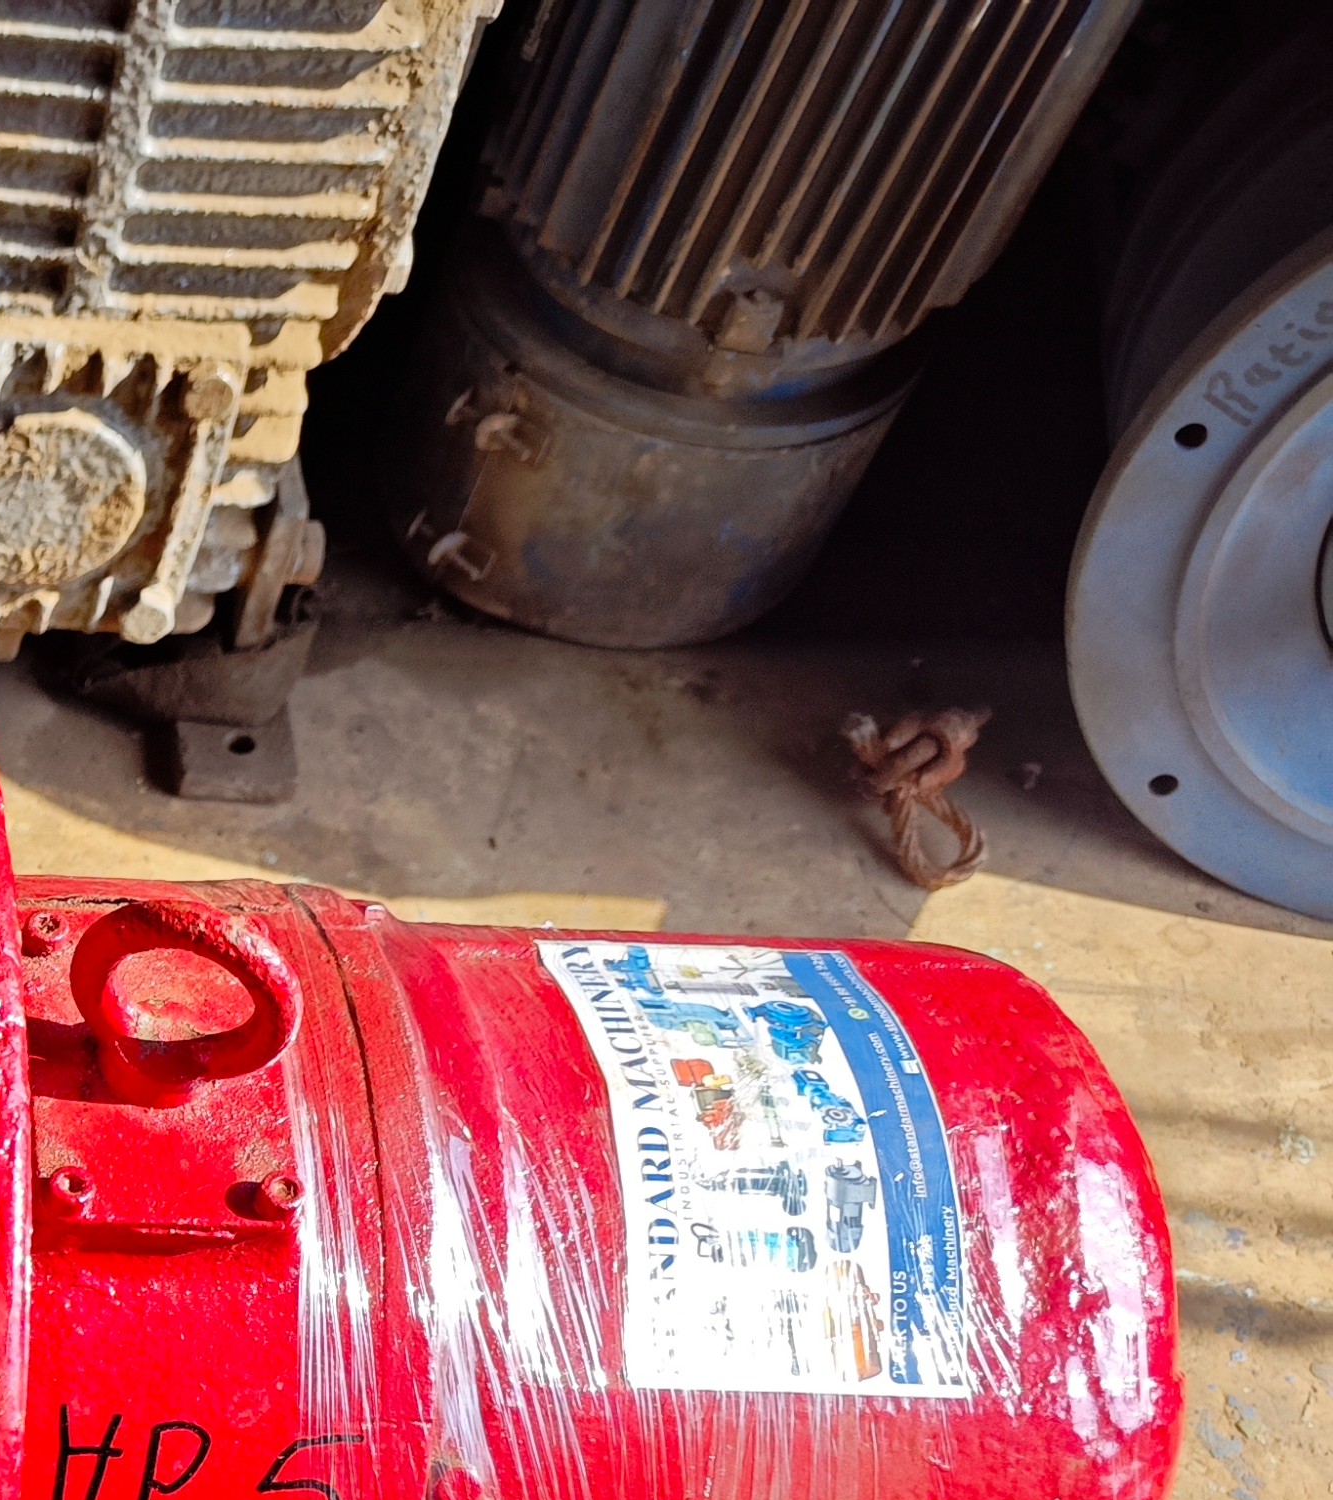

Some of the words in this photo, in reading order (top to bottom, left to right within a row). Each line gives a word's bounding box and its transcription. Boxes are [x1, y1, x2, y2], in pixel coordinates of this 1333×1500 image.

[561, 946, 664, 1111] MACHINERY
[867, 1031, 927, 1198] info@standarmachinery.com
[892, 1269, 908, 1294] US
[893, 1297, 908, 1325] TO
[891, 1328, 908, 1378] TLK
